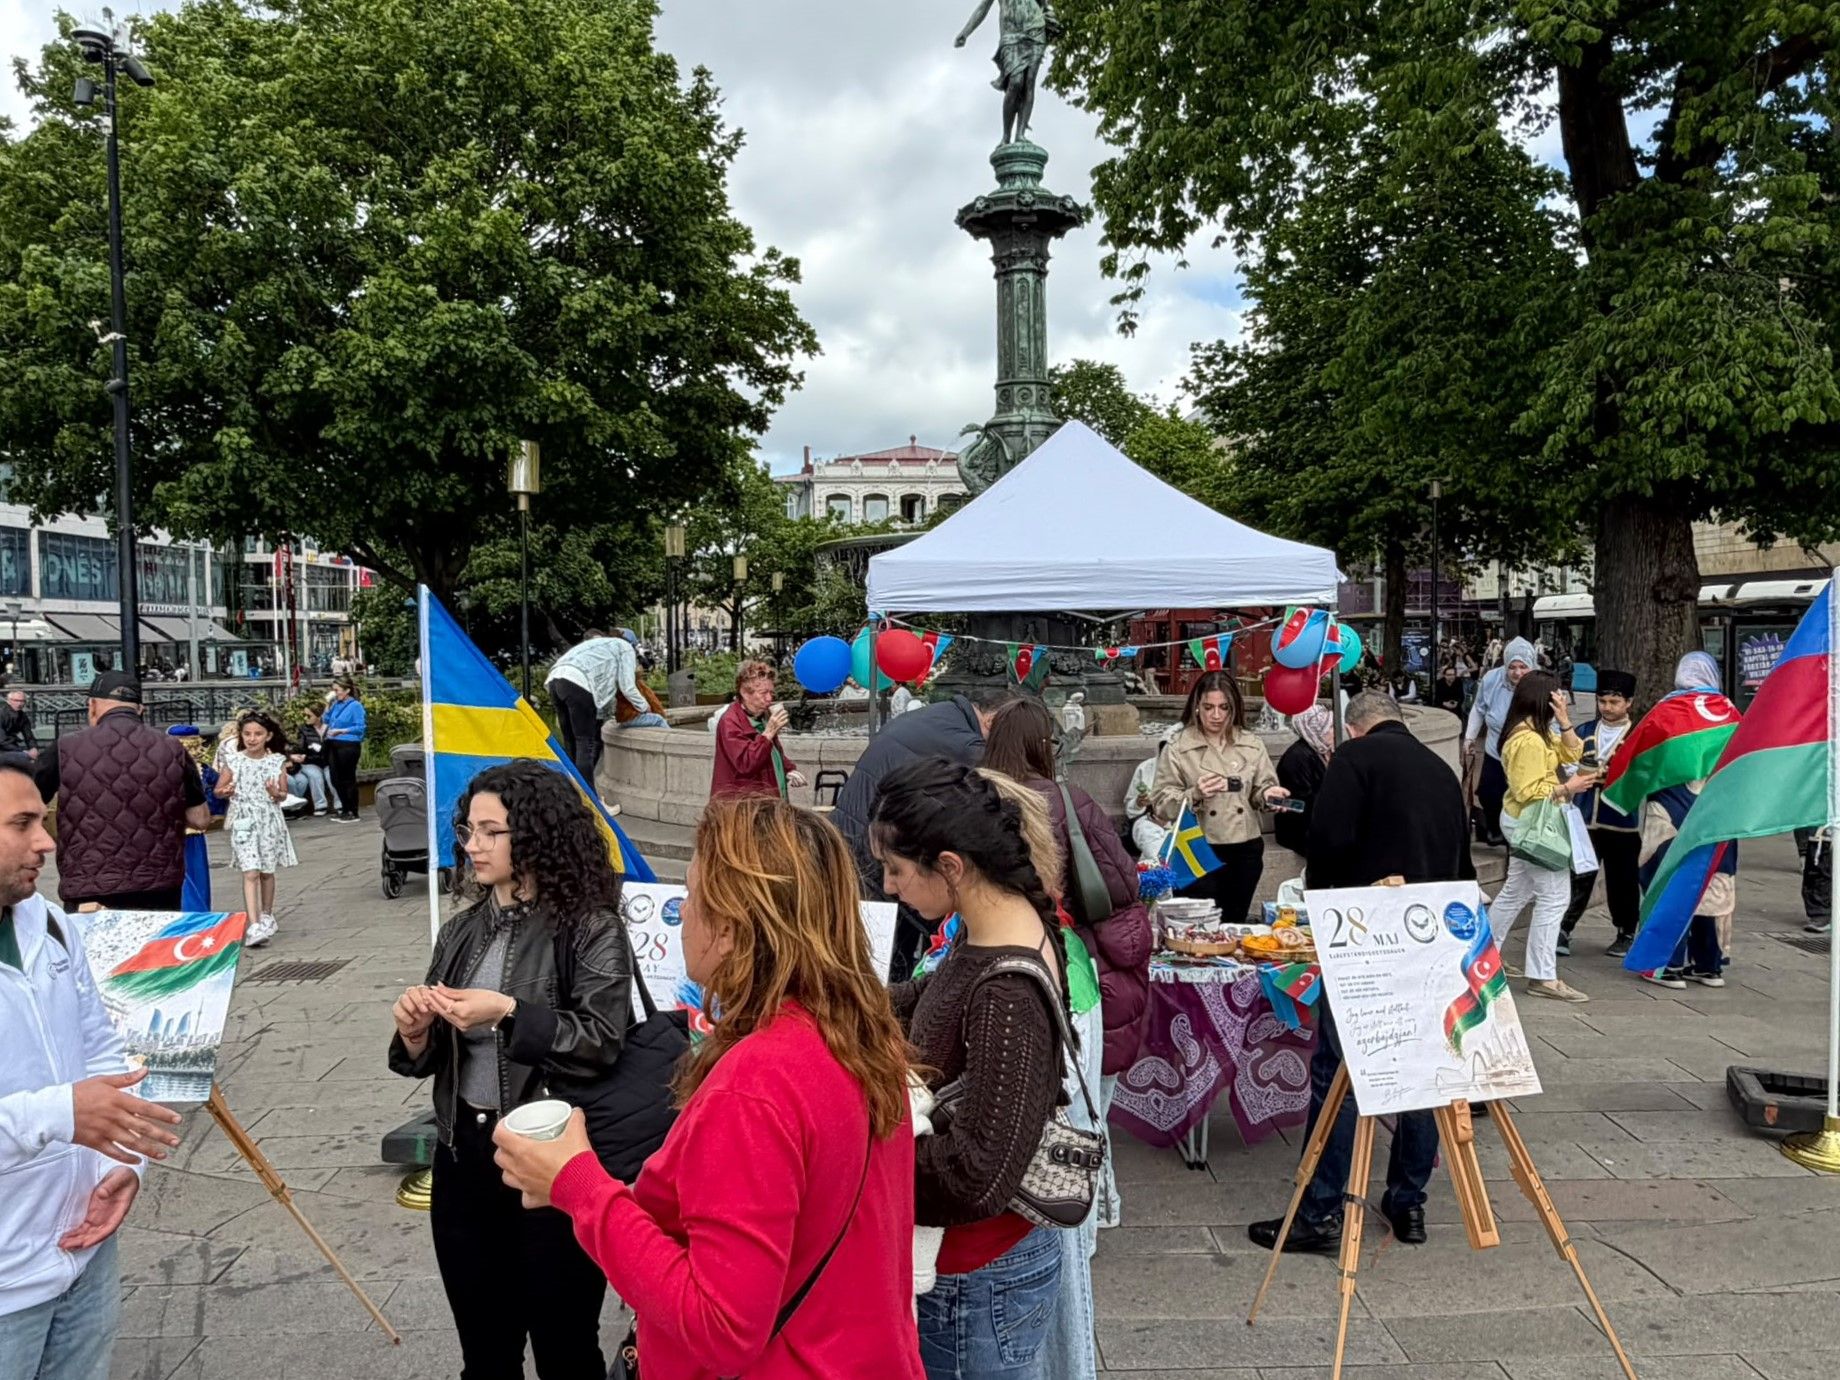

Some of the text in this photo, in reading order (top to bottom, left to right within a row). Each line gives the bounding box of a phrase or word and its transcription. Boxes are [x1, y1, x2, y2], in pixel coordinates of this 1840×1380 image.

[1323, 906, 1367, 948] 28
[1372, 931, 1400, 947] MAJ
[634, 931, 668, 961] 28
